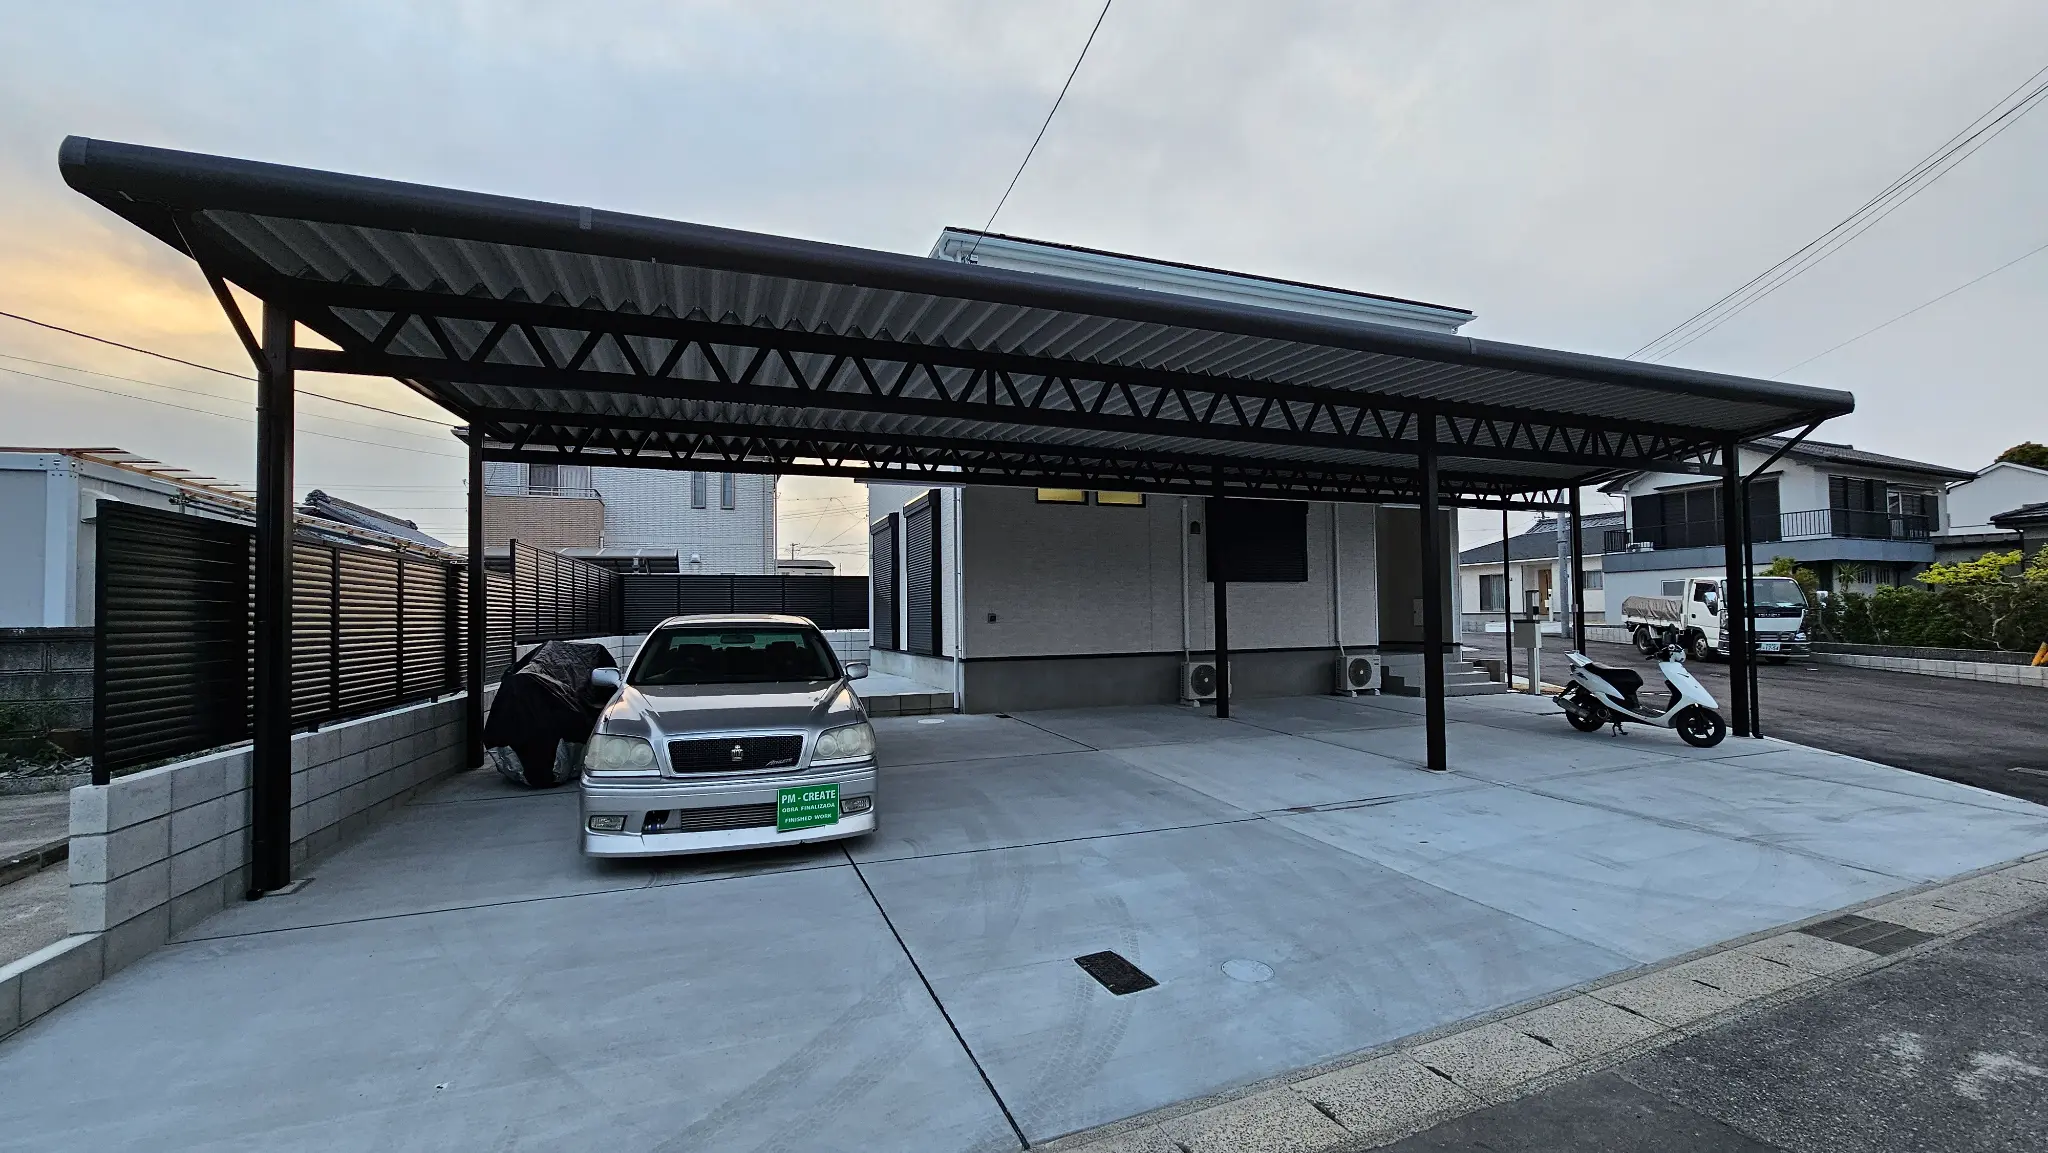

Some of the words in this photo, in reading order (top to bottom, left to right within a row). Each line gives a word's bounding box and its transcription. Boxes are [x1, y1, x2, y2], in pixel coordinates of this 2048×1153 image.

[781, 794, 796, 804] PM
[802, 790, 836, 801] CREATE
[801, 803, 835, 811] FINALIZADA
[785, 815, 813, 823] FINISHED
